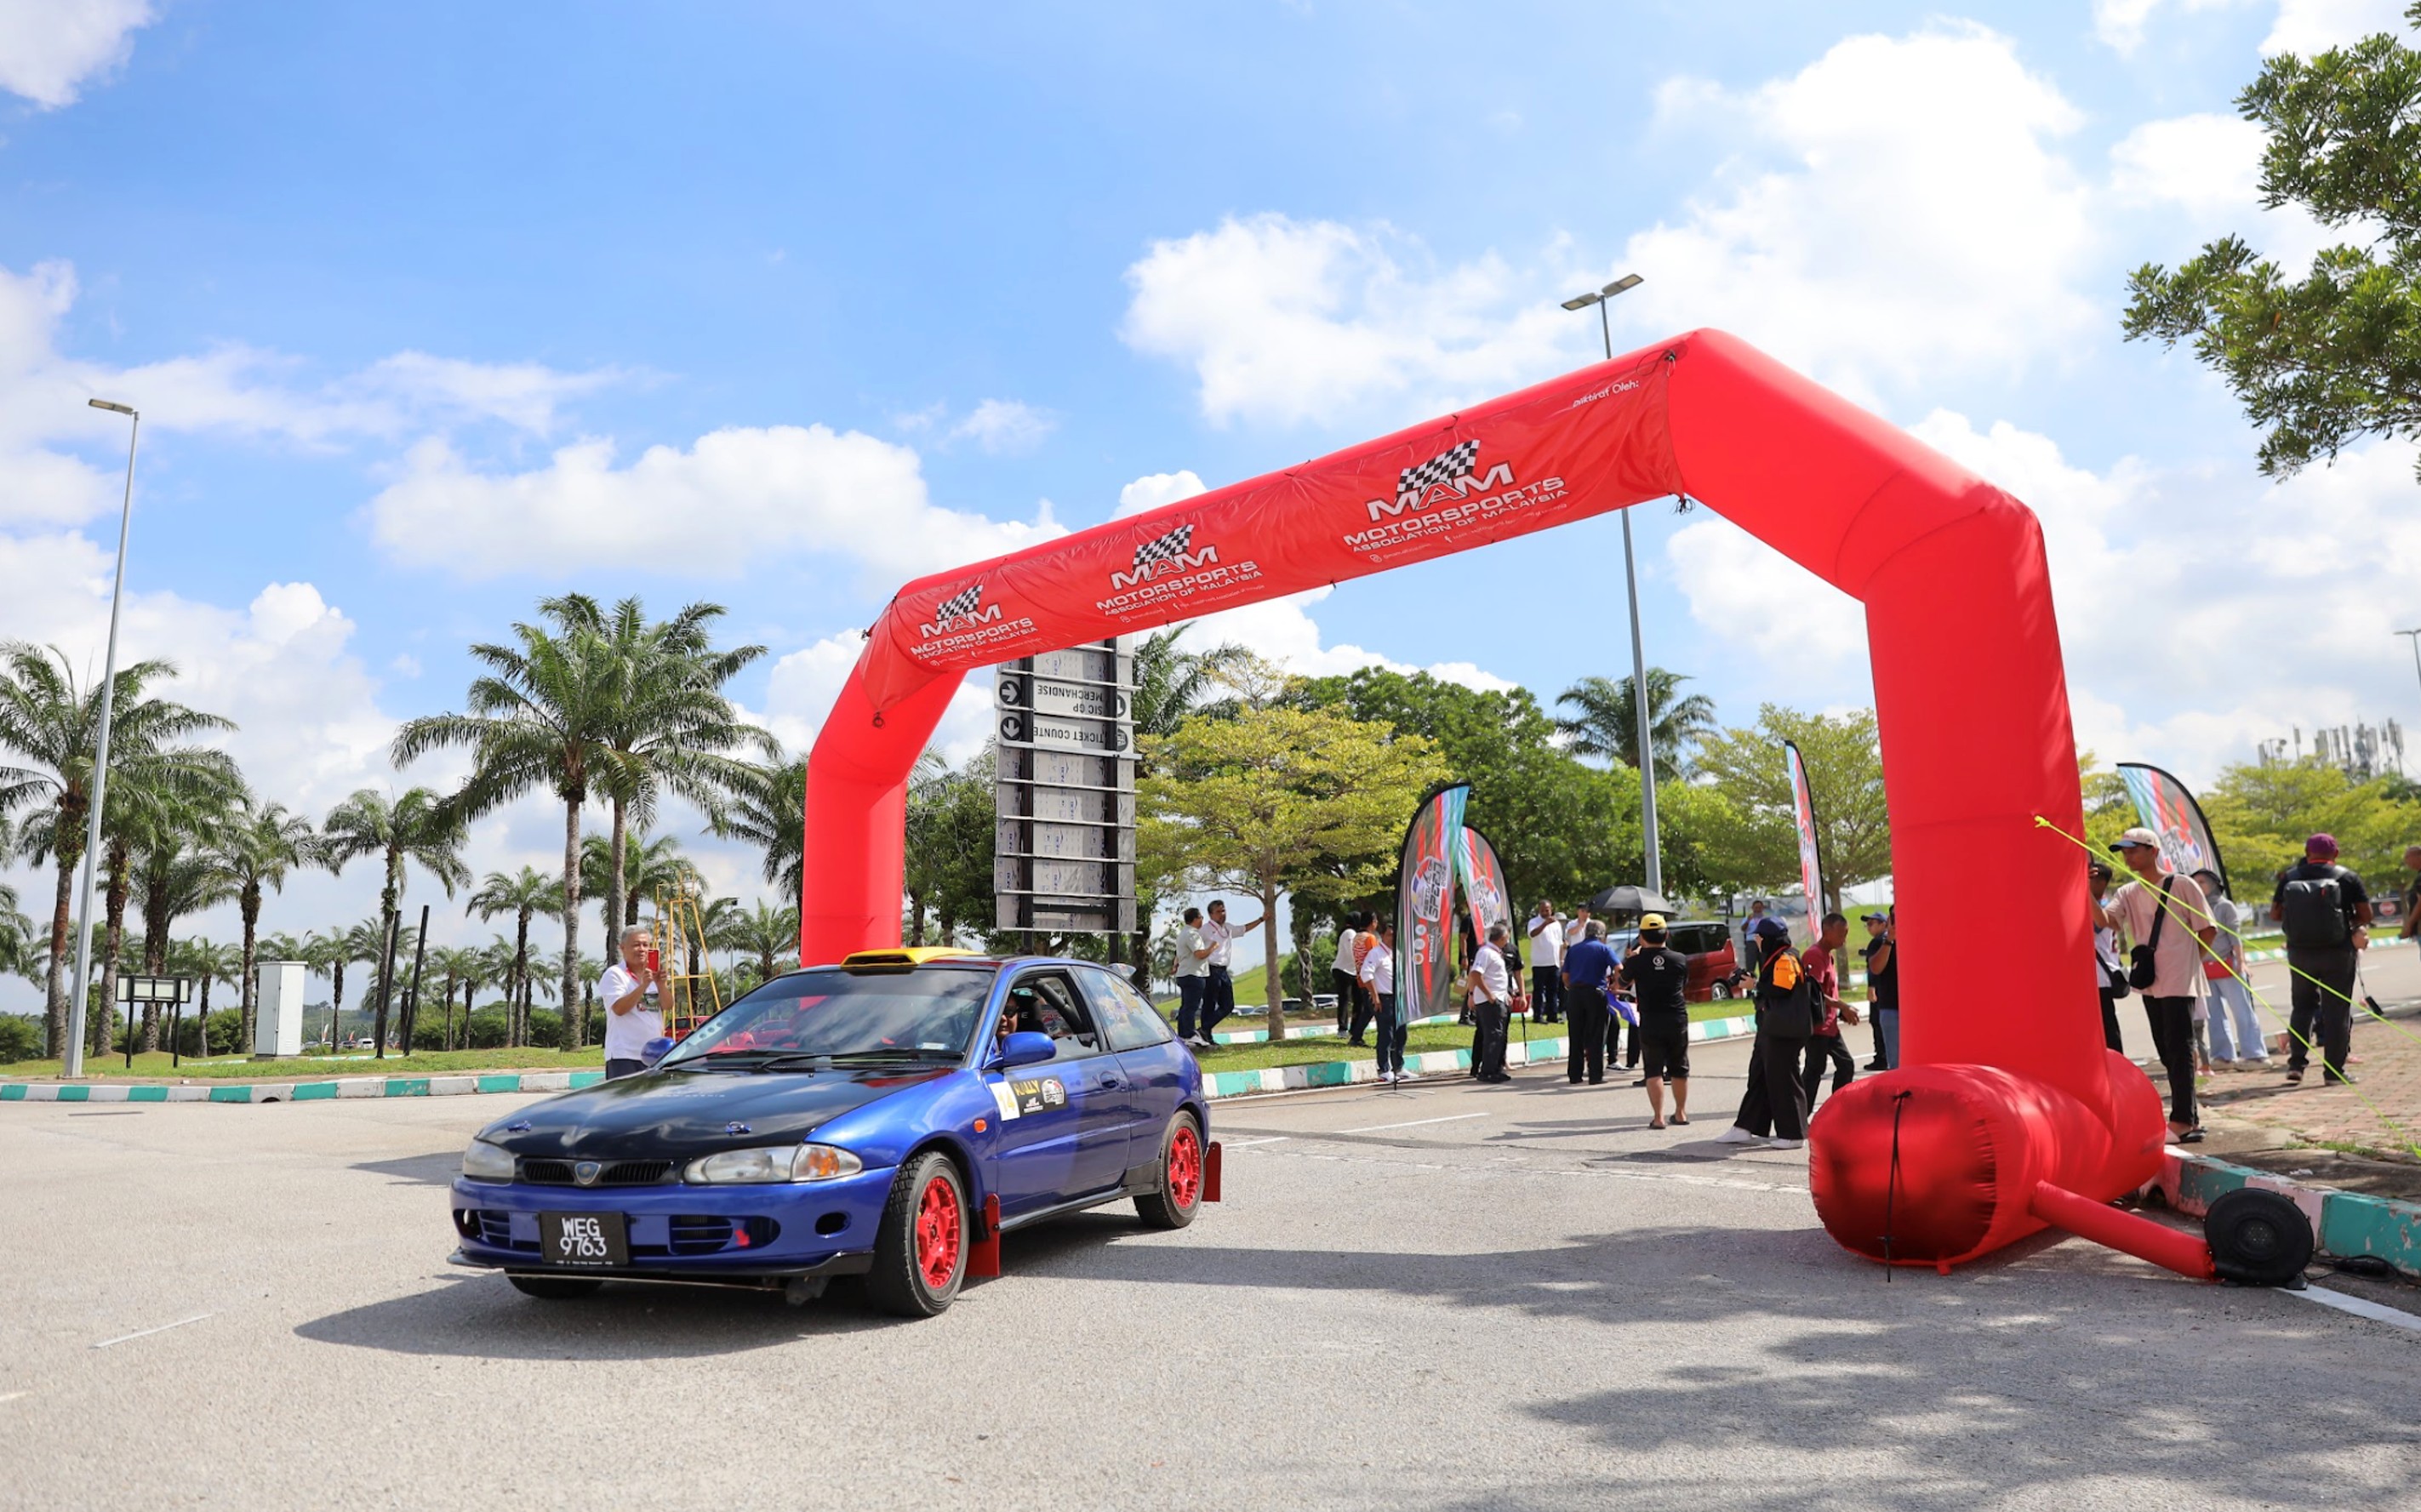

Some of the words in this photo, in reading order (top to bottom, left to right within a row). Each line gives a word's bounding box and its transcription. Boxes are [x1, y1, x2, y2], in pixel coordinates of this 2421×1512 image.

[1612, 379, 1639, 395] Oleh:
[1366, 460, 1516, 522] MAM
[1343, 476, 1565, 546] MOTORSPORTS
[1352, 523, 1453, 553] ASSOCIATION
[1455, 516, 1477, 528] OF
[1482, 489, 1569, 521] MALAYSIA
[1110, 545, 1219, 591] MAM
[1095, 561, 1259, 610] MOTORSPORTS
[1105, 592, 1177, 616] ASSOCIATION
[1179, 587, 1196, 597] OF
[1199, 570, 1263, 591] MALAYSIA
[919, 603, 1002, 638] MAM
[910, 617, 1034, 656] MOTORSPORTS
[990, 626, 1038, 643] MALAYSIA
[1037, 684, 1104, 702] MERCHANDISE
[1072, 703, 1086, 713] GP
[1088, 705, 1103, 716] SIC
[1033, 727, 1071, 739] COUNTE
[1073, 730, 1105, 744] TICKET
[1429, 862, 1442, 919] SPEED
[1013, 1079, 1040, 1097] RALLY
[562, 1218, 601, 1237] WEG
[559, 1236, 608, 1258] 9763
